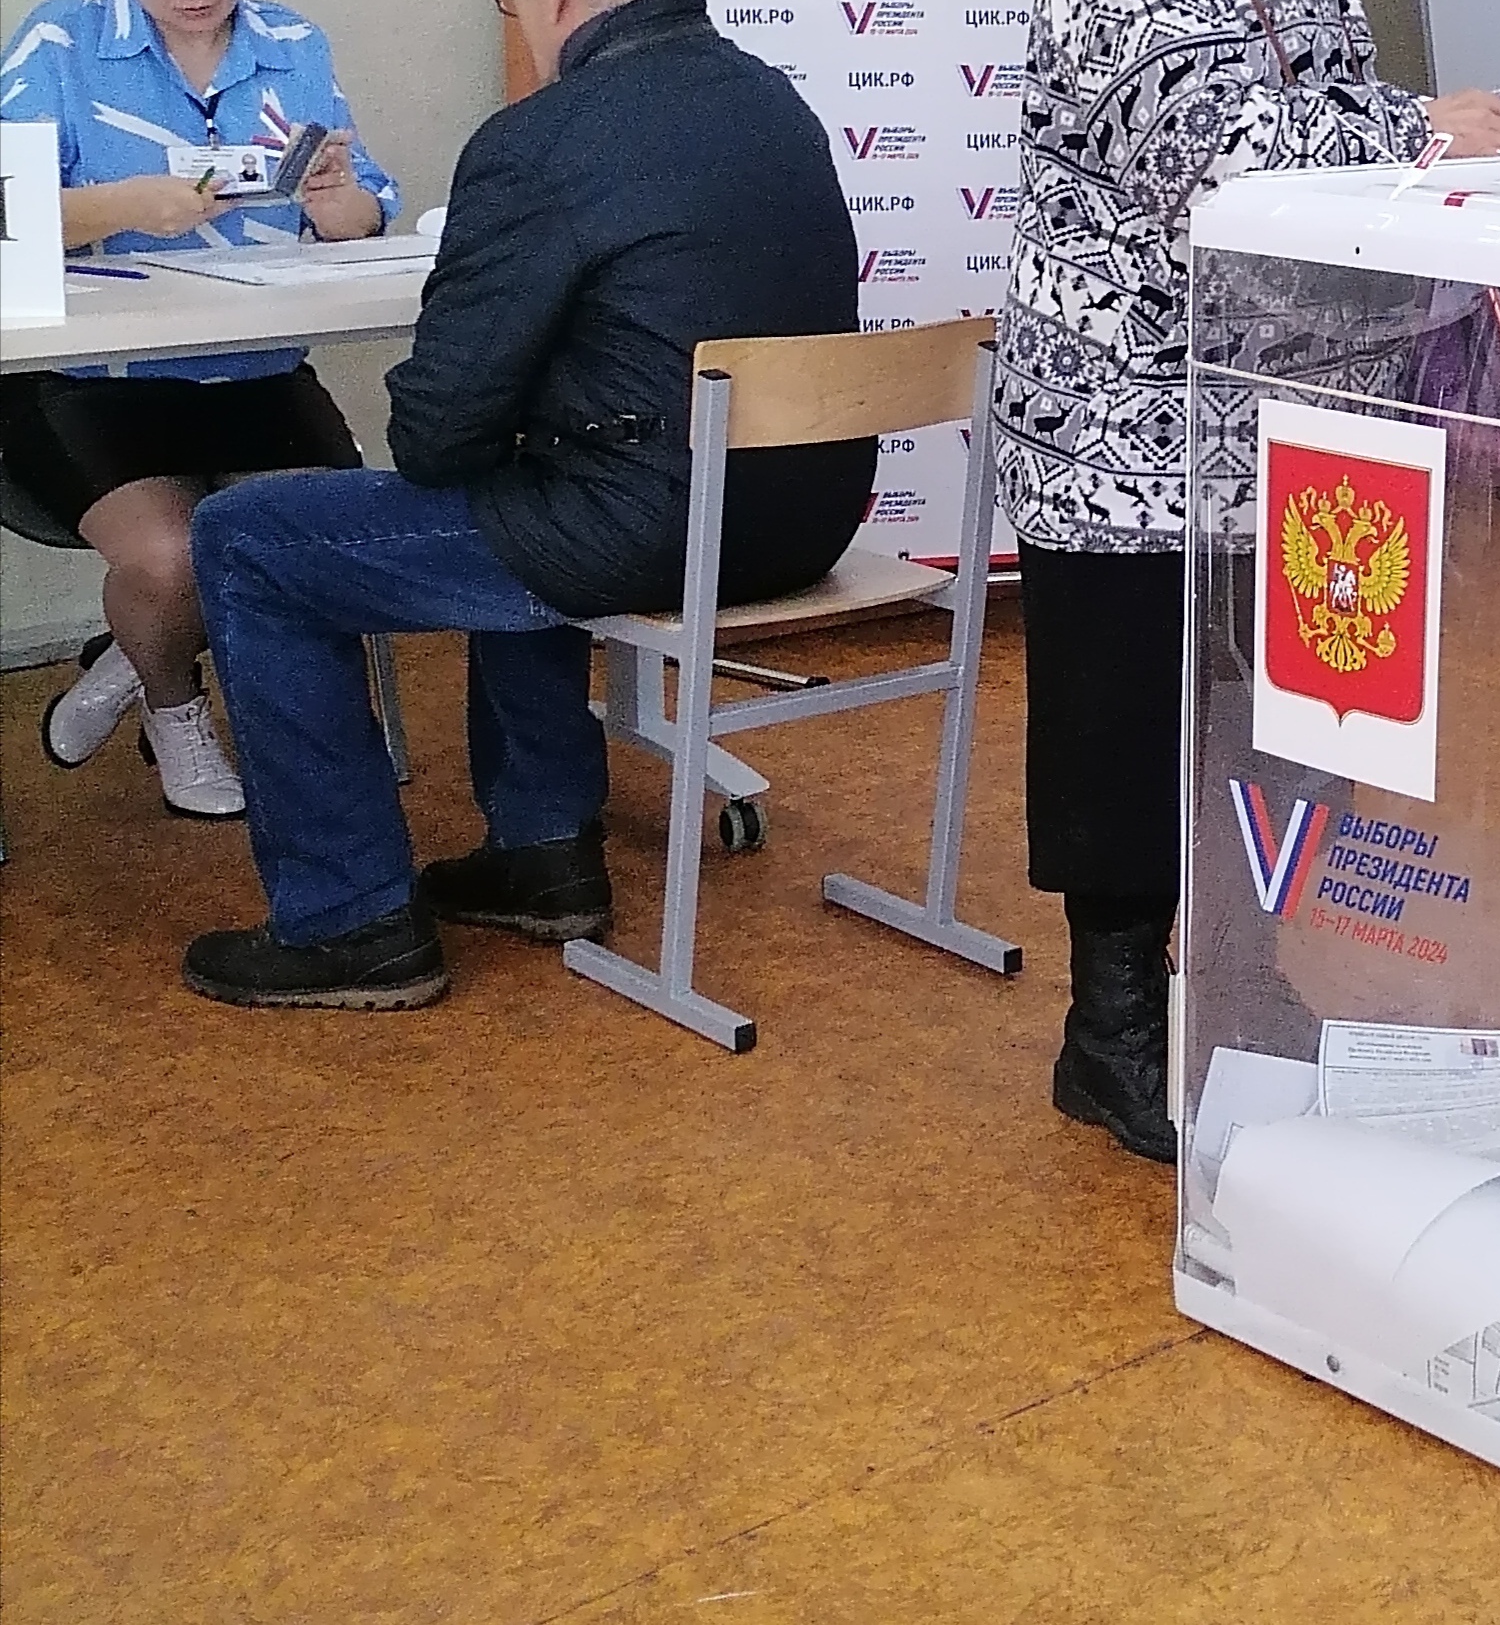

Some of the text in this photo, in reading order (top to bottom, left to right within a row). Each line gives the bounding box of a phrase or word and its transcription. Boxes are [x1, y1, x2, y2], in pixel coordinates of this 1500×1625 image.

[725, 8, 795, 27] ЦИК.РФ
[965, 9, 1030, 28] ЦИК.РФ
[848, 71, 915, 91] ЦИК.РФ
[966, 132, 1017, 152] ЦИК.Р
[848, 195, 915, 215] ЦИК.РФ
[877, 438, 916, 454] К.РФ
[1338, 812, 1440, 859] ВЫБОРЫ
[1327, 844, 1471, 904] ПРЕЗИДЕНТА
[1316, 875, 1406, 923] РОССИИ
[1352, 921, 1404, 955] МАРТА
[1406, 935, 1449, 964] 2024
